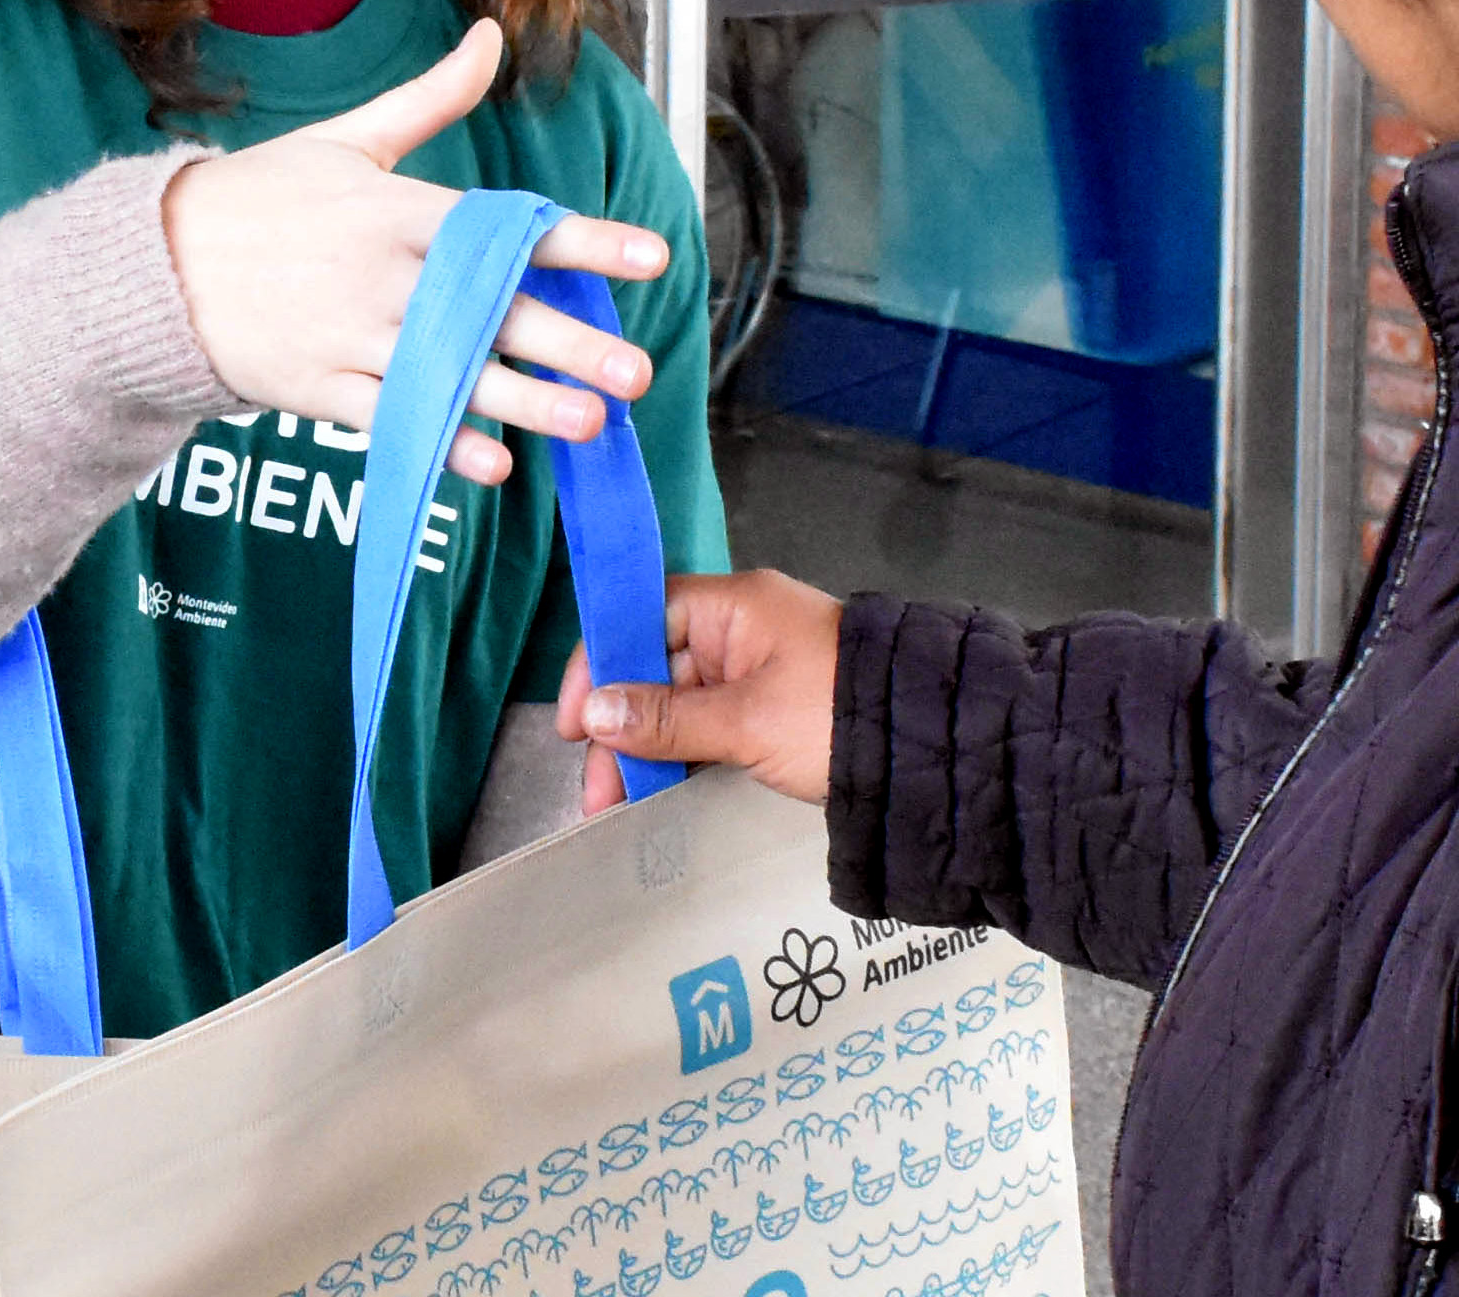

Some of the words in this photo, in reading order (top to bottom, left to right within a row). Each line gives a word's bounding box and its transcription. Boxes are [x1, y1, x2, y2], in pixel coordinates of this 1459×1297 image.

[177, 592, 238, 616] Montevideo
[174, 607, 228, 629] Ambiente
[863, 923, 990, 993] Ambiente
